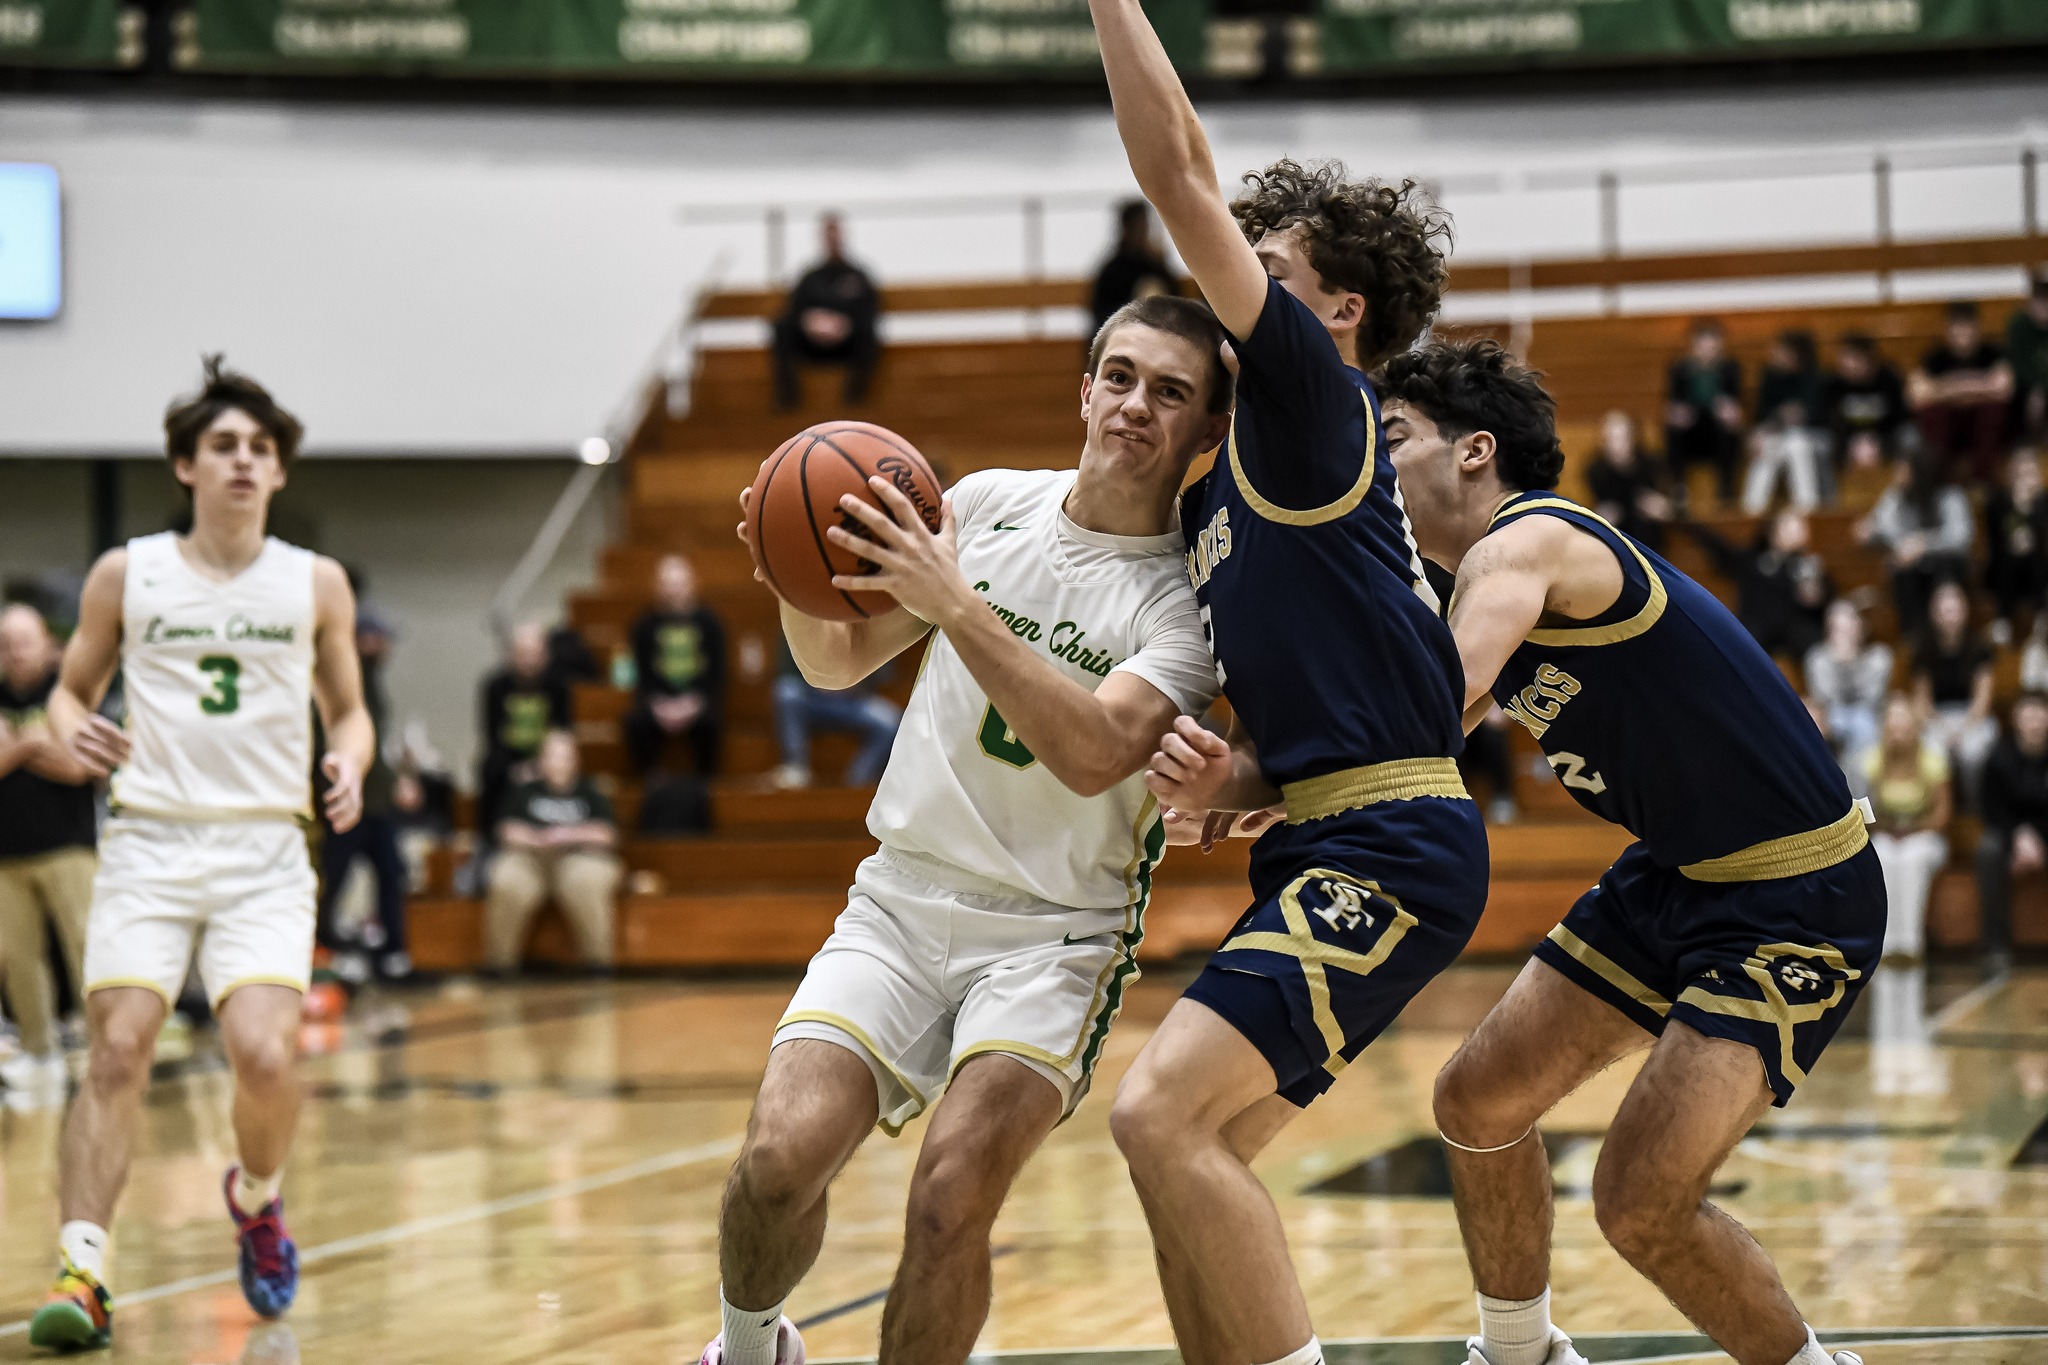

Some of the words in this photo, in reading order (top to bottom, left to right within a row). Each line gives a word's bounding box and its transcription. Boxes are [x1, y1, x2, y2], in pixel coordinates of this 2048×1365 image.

[1049, 621, 1126, 677] Chris
[199, 655, 240, 715] 3
[1503, 663, 1582, 740] NCIS
